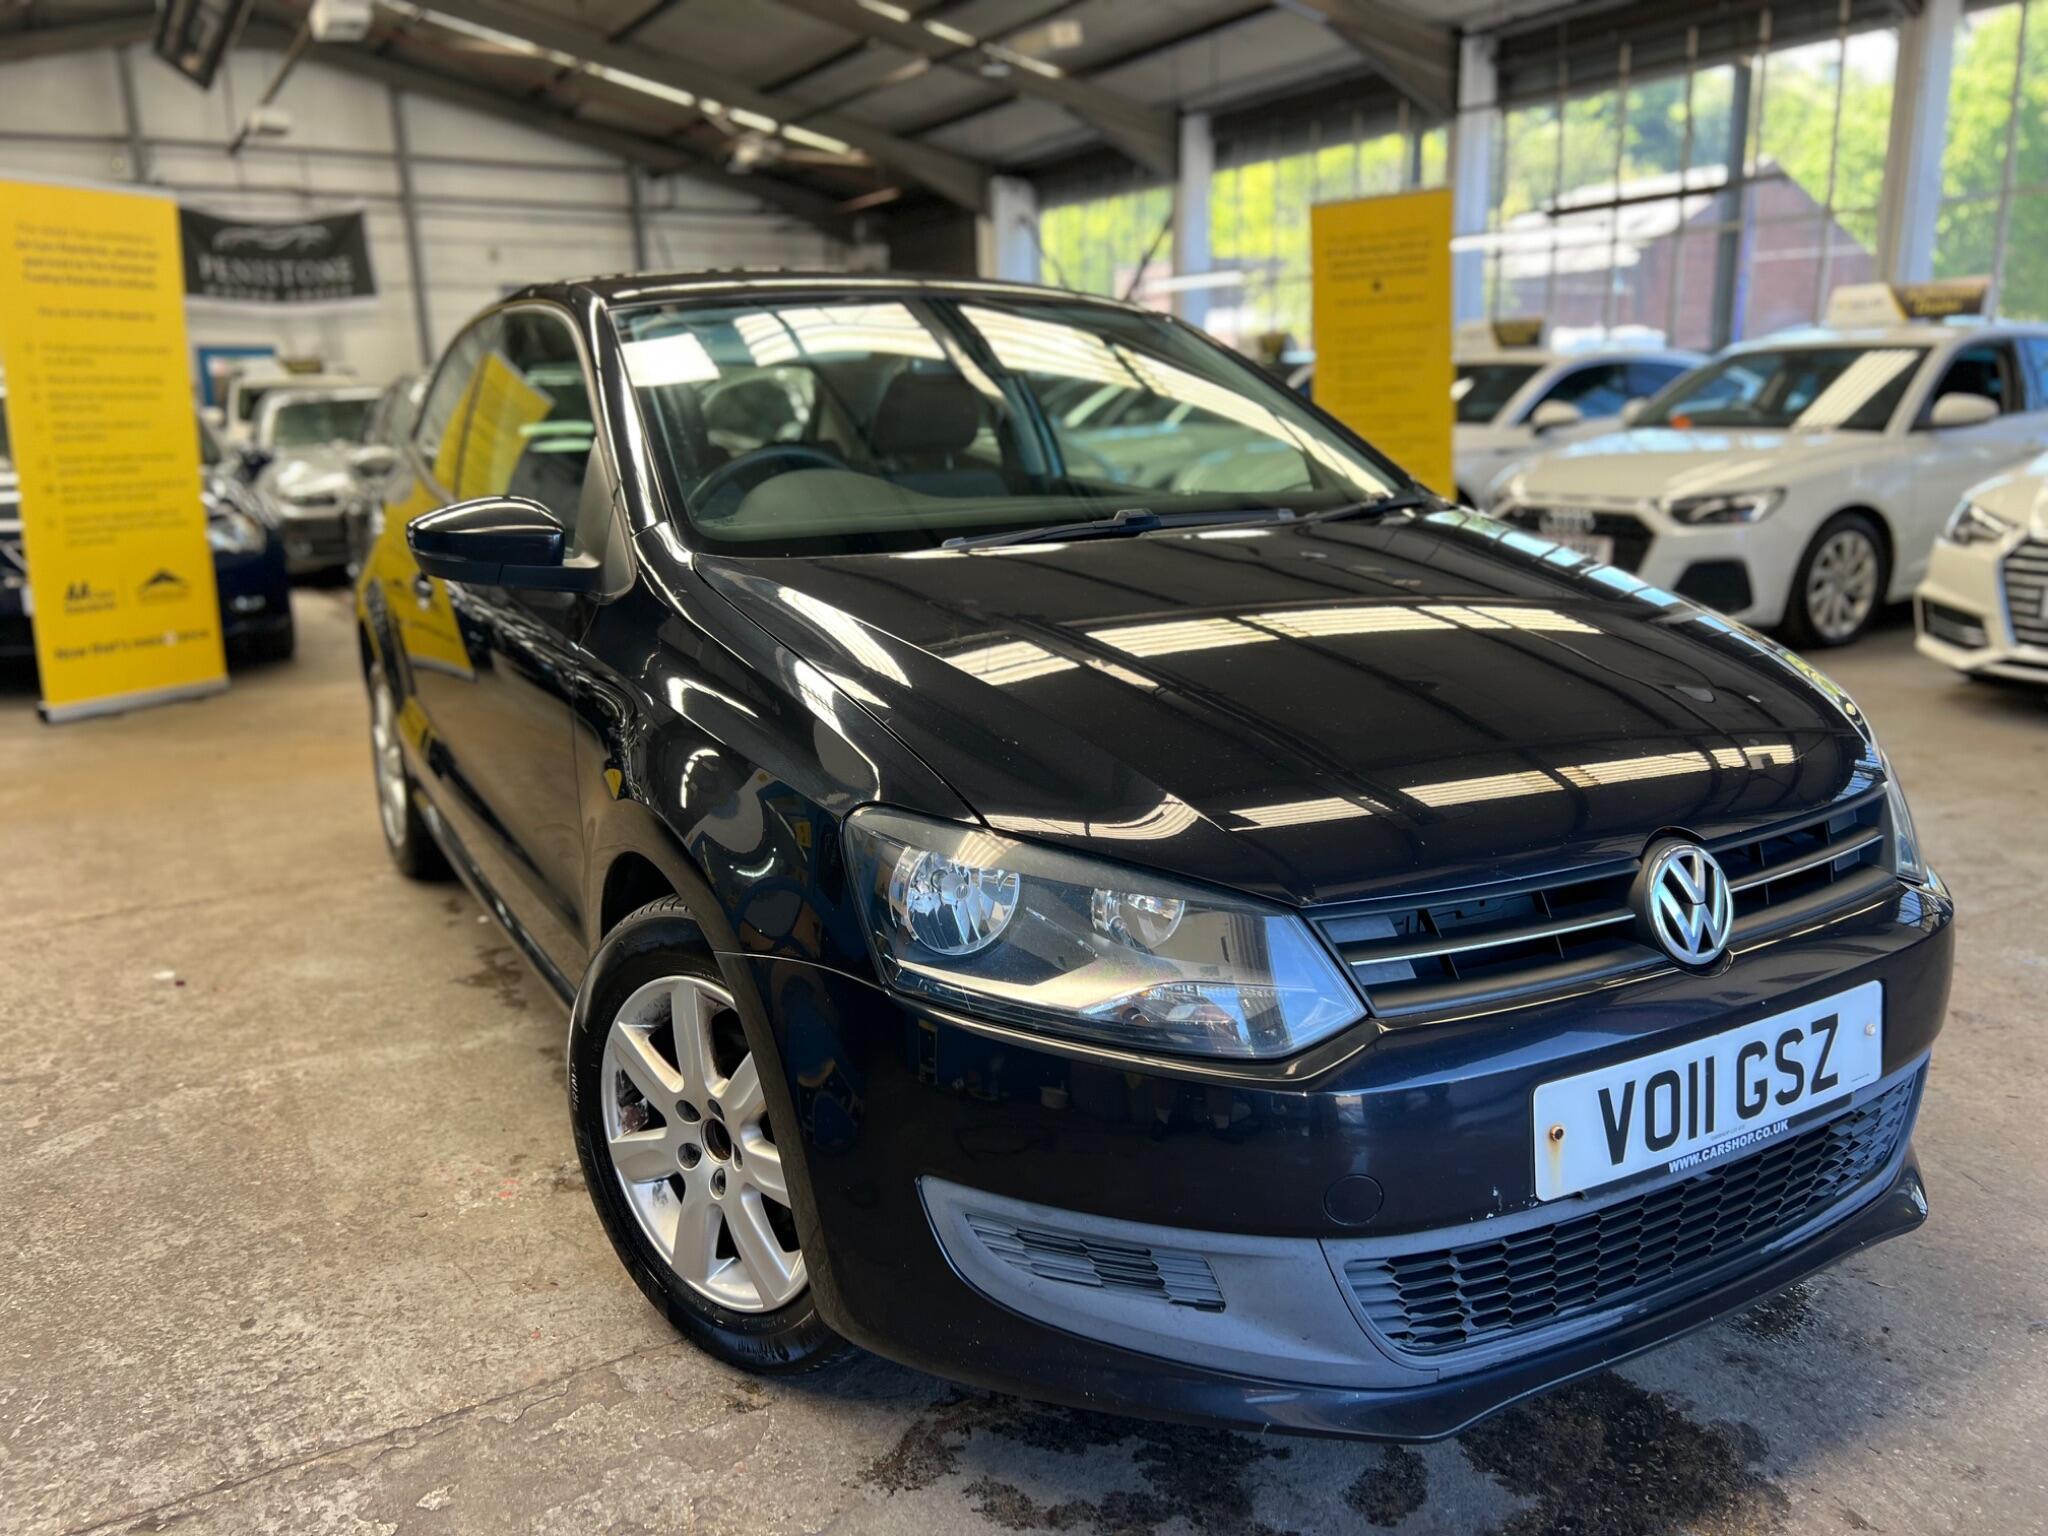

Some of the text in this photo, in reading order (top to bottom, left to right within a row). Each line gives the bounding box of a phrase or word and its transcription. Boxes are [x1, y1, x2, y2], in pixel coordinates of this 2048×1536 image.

[1598, 1012, 1840, 1165] VO11 GSZ
[1667, 1119, 1790, 1175] WWW.CARSHOP.CO.UK
